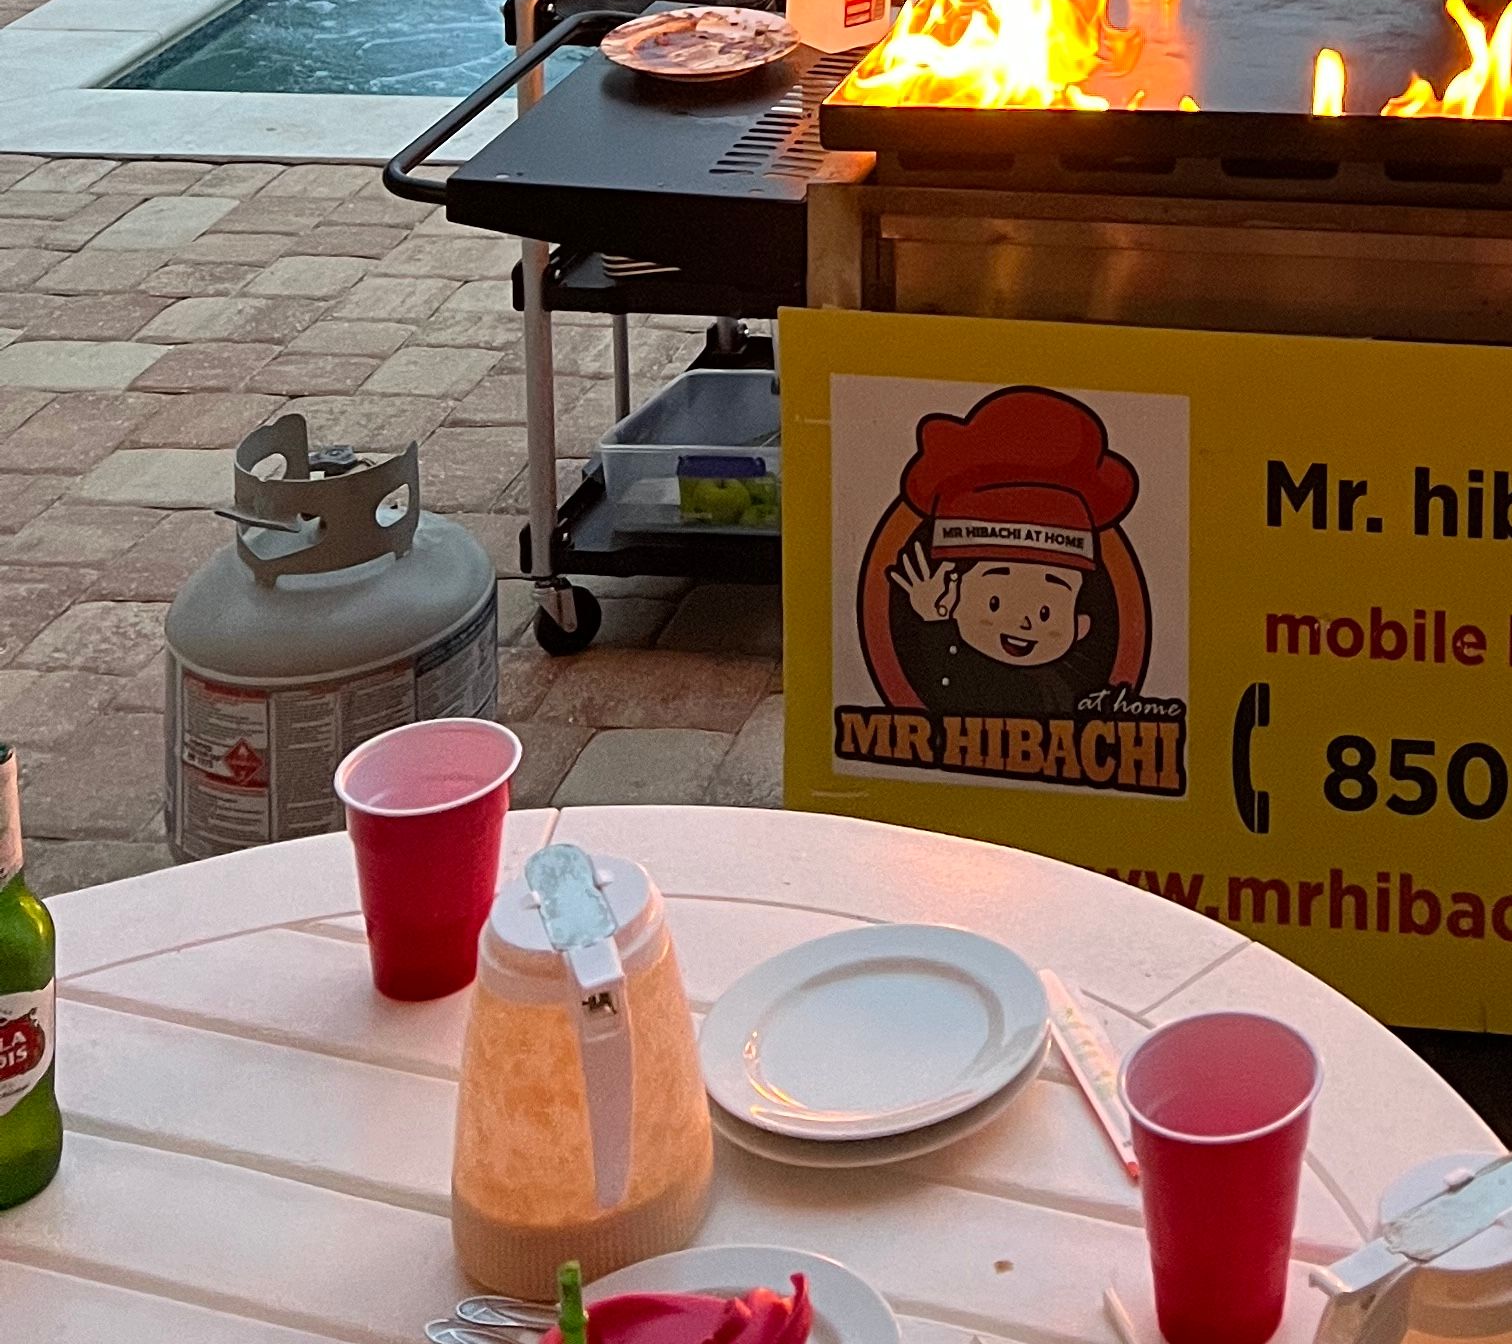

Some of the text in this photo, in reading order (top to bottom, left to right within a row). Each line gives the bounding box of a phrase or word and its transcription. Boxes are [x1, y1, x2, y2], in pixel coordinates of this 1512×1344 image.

[1267, 460, 1383, 533] Mr.
[942, 526, 1085, 550] MR HIBACHI AT HOME
[1265, 606, 1487, 666] mobile
[1077, 688, 1182, 717] at home
[840, 712, 1181, 790] MR HIBACHI
